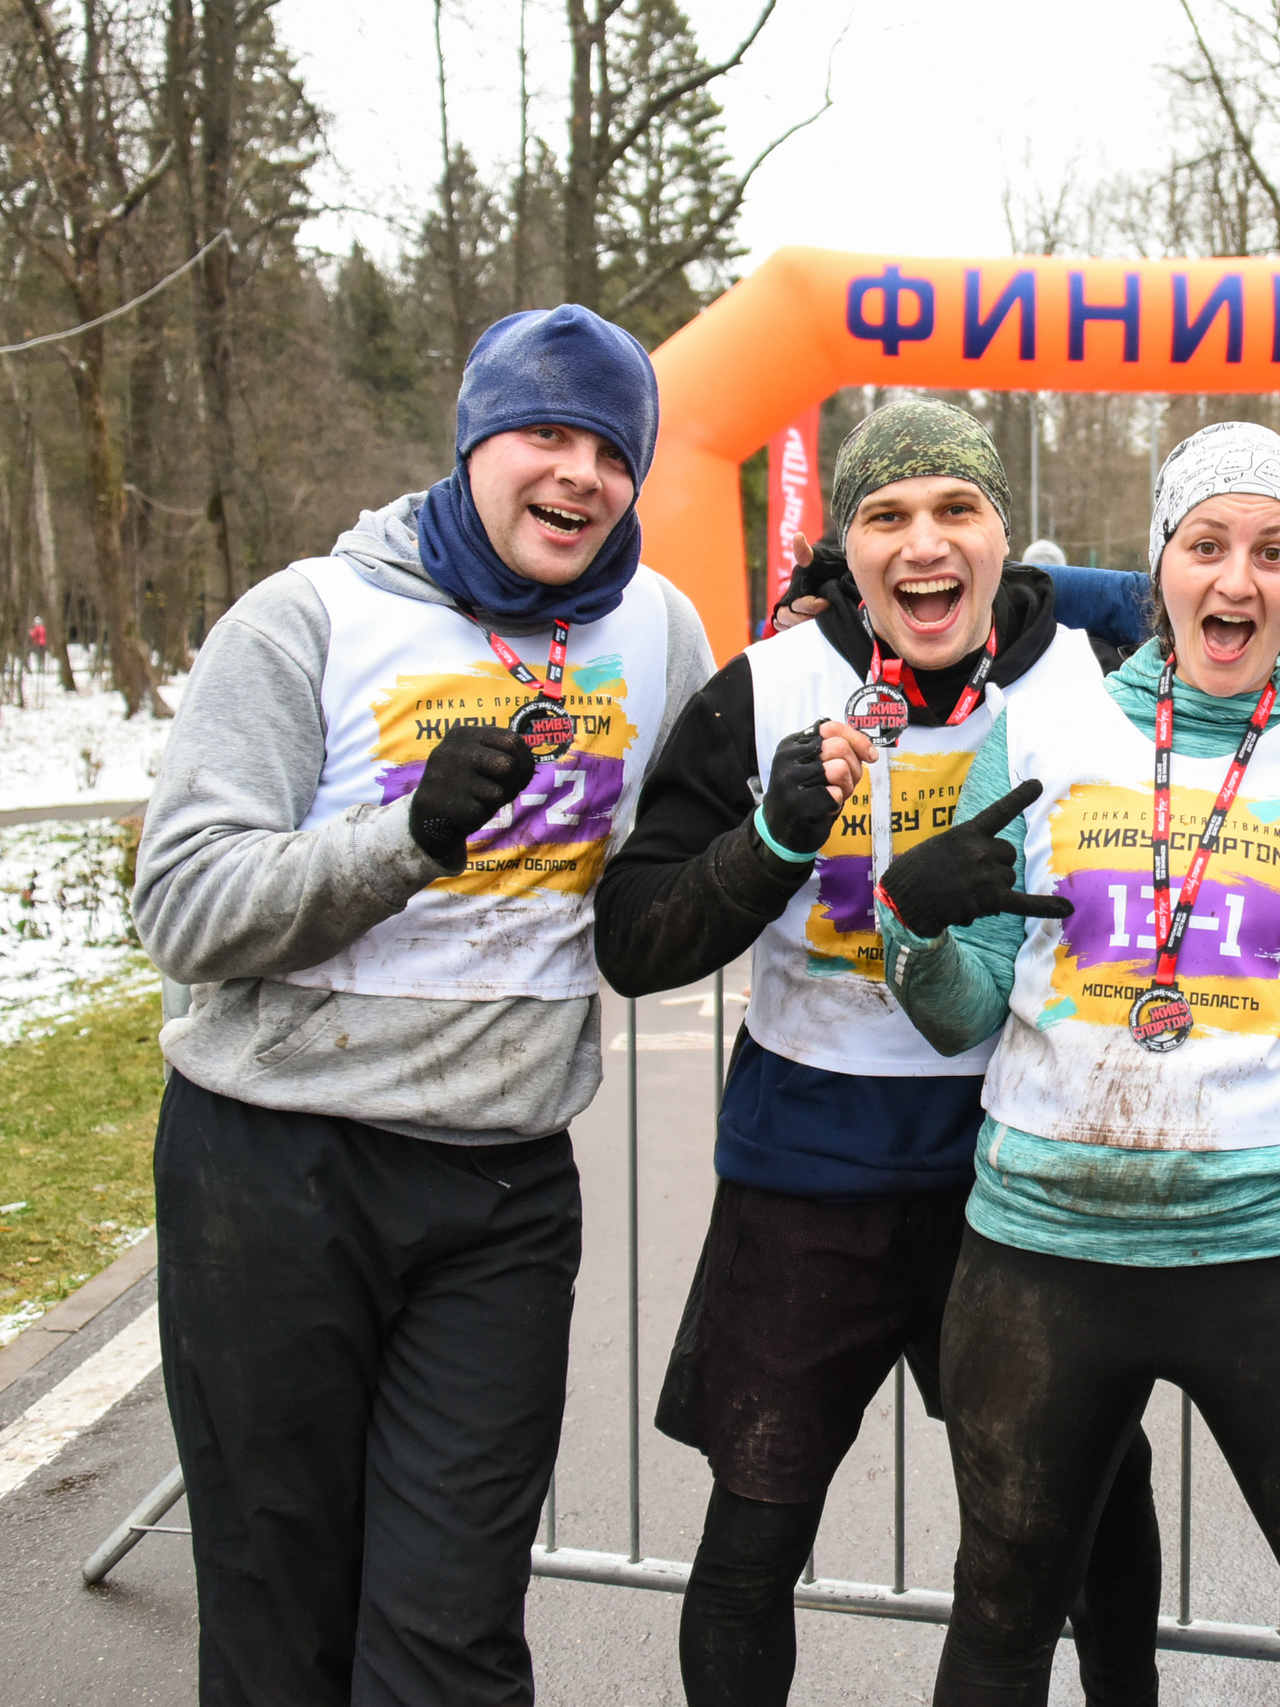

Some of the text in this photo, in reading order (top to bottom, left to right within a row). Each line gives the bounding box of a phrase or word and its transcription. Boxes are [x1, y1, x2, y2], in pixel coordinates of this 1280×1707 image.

[415, 694, 613, 710] ГОНКА С ПРЕПВИЯМИ
[868, 702, 907, 715] ЖИВУ
[532, 717, 573, 733] ЖИВУ
[847, 715, 908, 729] СПОРТОМ
[521, 730, 574, 747] ПОРТОМ
[901, 791, 908, 801] С
[841, 809, 920, 837] ЖВУ
[1082, 811, 1129, 821] ГОНКА
[1140, 812, 1147, 821] С
[1077, 828, 1154, 850] ЖИВУ
[466, 857, 577, 872] ОВСКАЯ ОБЛАСТЬ
[1081, 983, 1185, 1002] МОСКОВ
[1189, 991, 1260, 1011] ОБЛАСТЬ
[1151, 1001, 1189, 1021] ЖИВУ
[1132, 1014, 1193, 1040] СПОРТОМ
